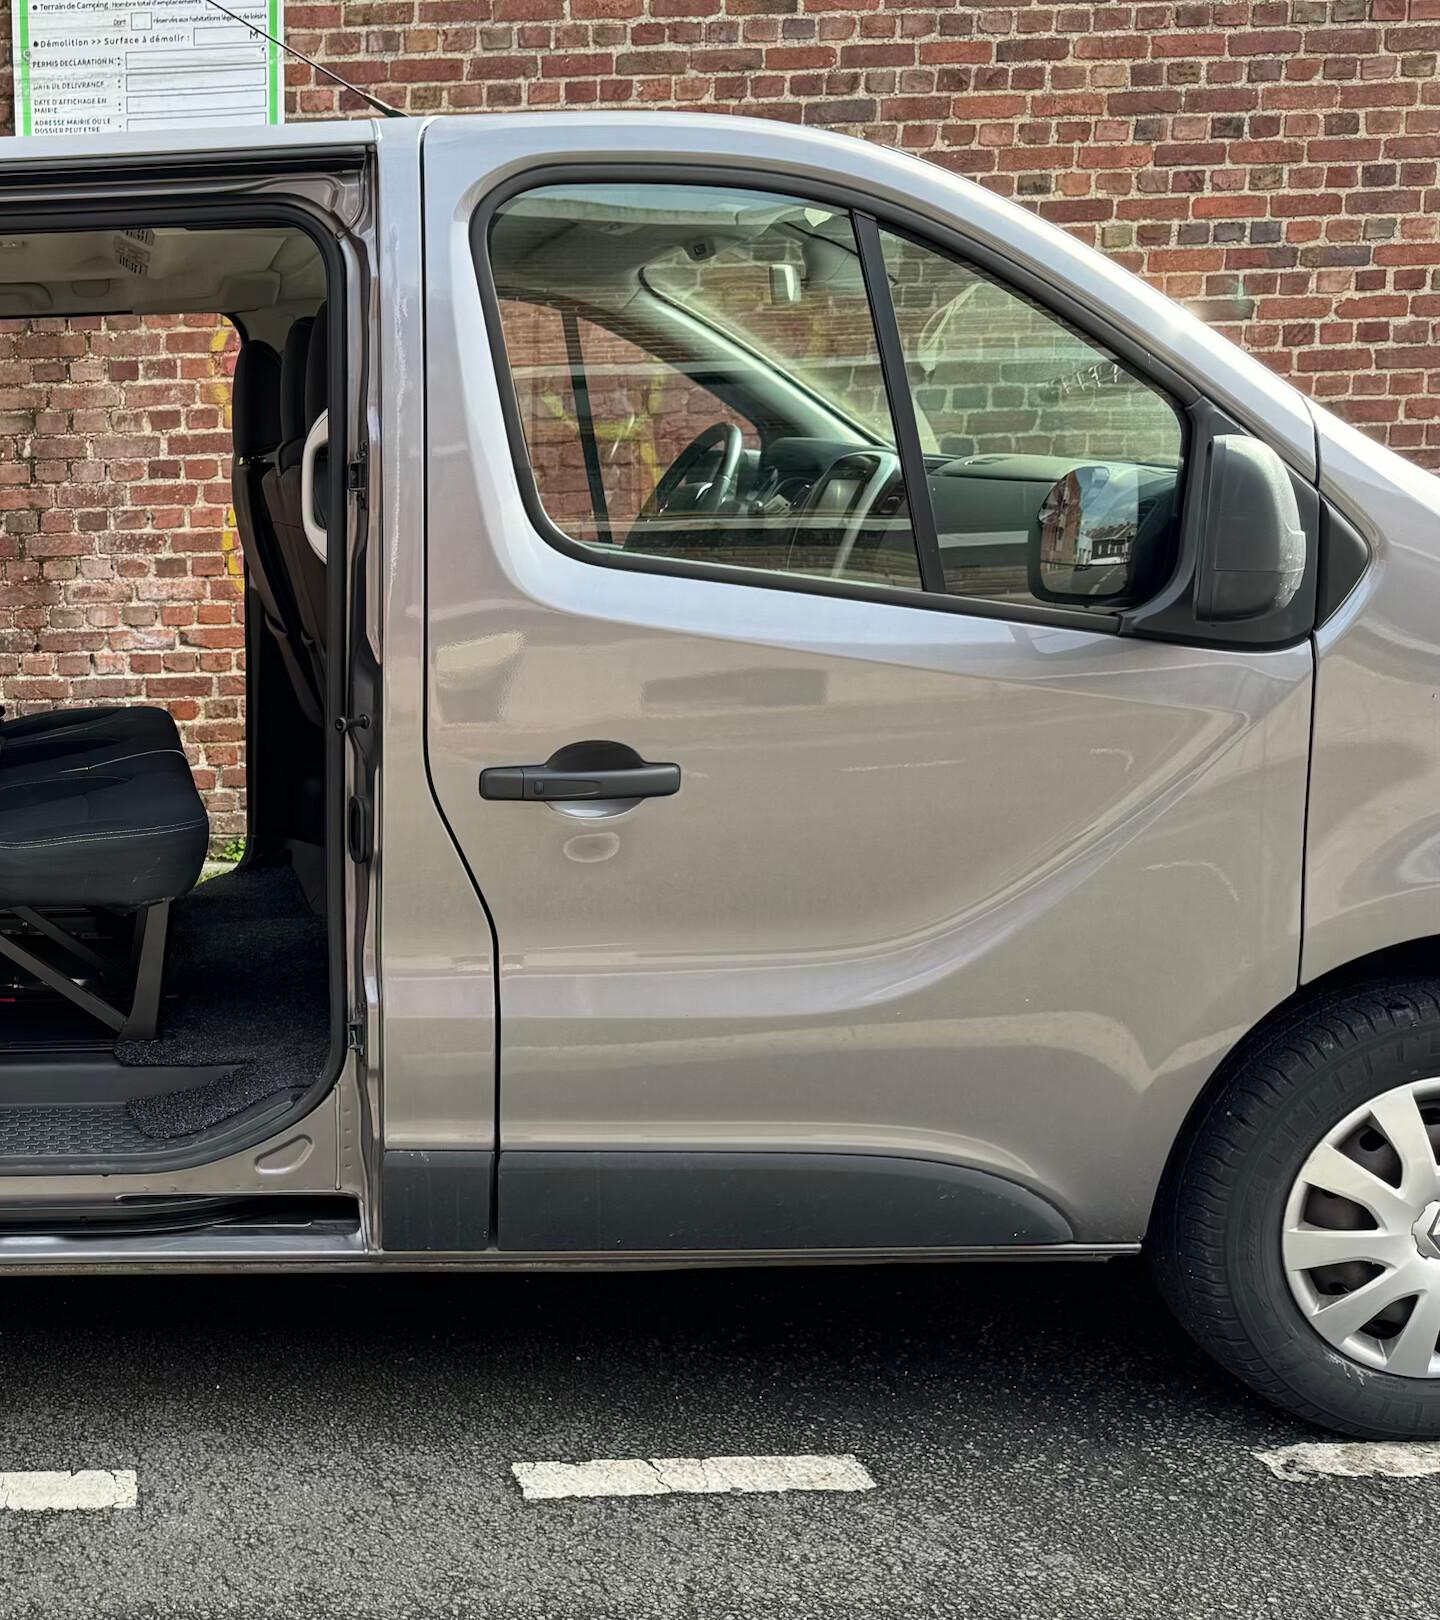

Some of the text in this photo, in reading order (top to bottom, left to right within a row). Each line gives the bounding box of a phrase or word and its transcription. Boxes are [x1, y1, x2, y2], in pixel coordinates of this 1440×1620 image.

[40, 3, 65, 11] Terrain
[66, 2, 75, 10] de
[40, 39, 89, 48] Démolition
[104, 36, 139, 45] Surface
[149, 34, 184, 43] démolir
[32, 60, 58, 68] PERMIS
[60, 58, 107, 67] DECLARATION
